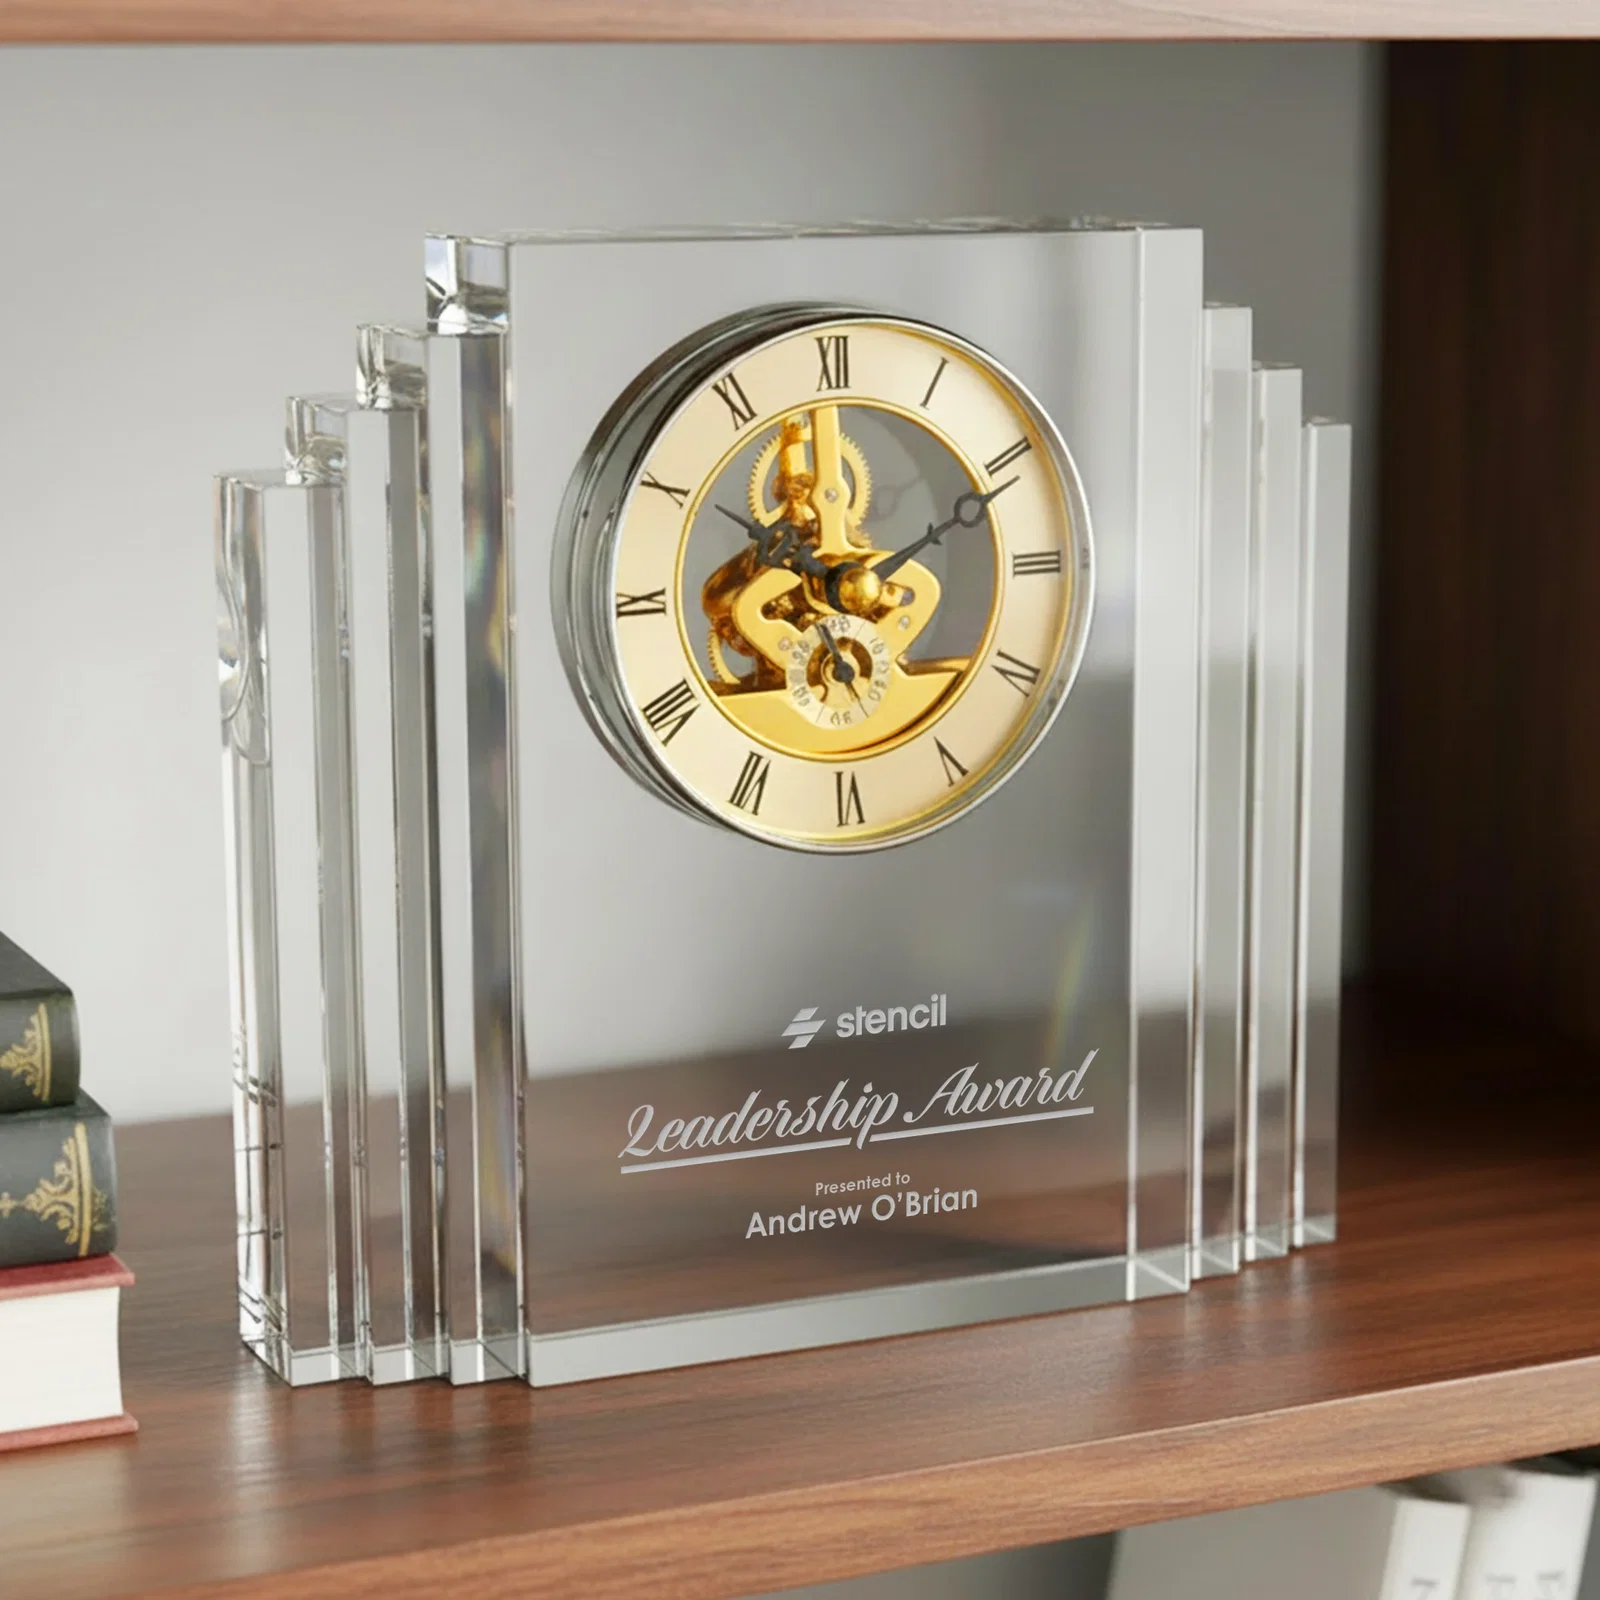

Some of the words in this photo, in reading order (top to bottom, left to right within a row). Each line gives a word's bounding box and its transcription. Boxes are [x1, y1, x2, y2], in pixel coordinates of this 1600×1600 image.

[815, 336, 850, 392] XII
[920, 357, 950, 410] I
[712, 371, 758, 431] XI
[984, 436, 1033, 477] II
[640, 472, 691, 509] X
[1013, 549, 1061, 576] III
[616, 588, 667, 619] IX
[991, 649, 1041, 698] IV
[641, 678, 700, 747] VIII
[727, 750, 772, 816] VII
[933, 737, 969, 788] V
[835, 770, 866, 827] VI
[836, 993, 947, 1038] stencil
[618, 1078, 899, 1158] Leadership
[902, 1048, 1099, 1123] Award
[815, 1172, 892, 1196] Presented
[895, 1171, 911, 1186] to
[745, 1204, 863, 1239] Andrew
